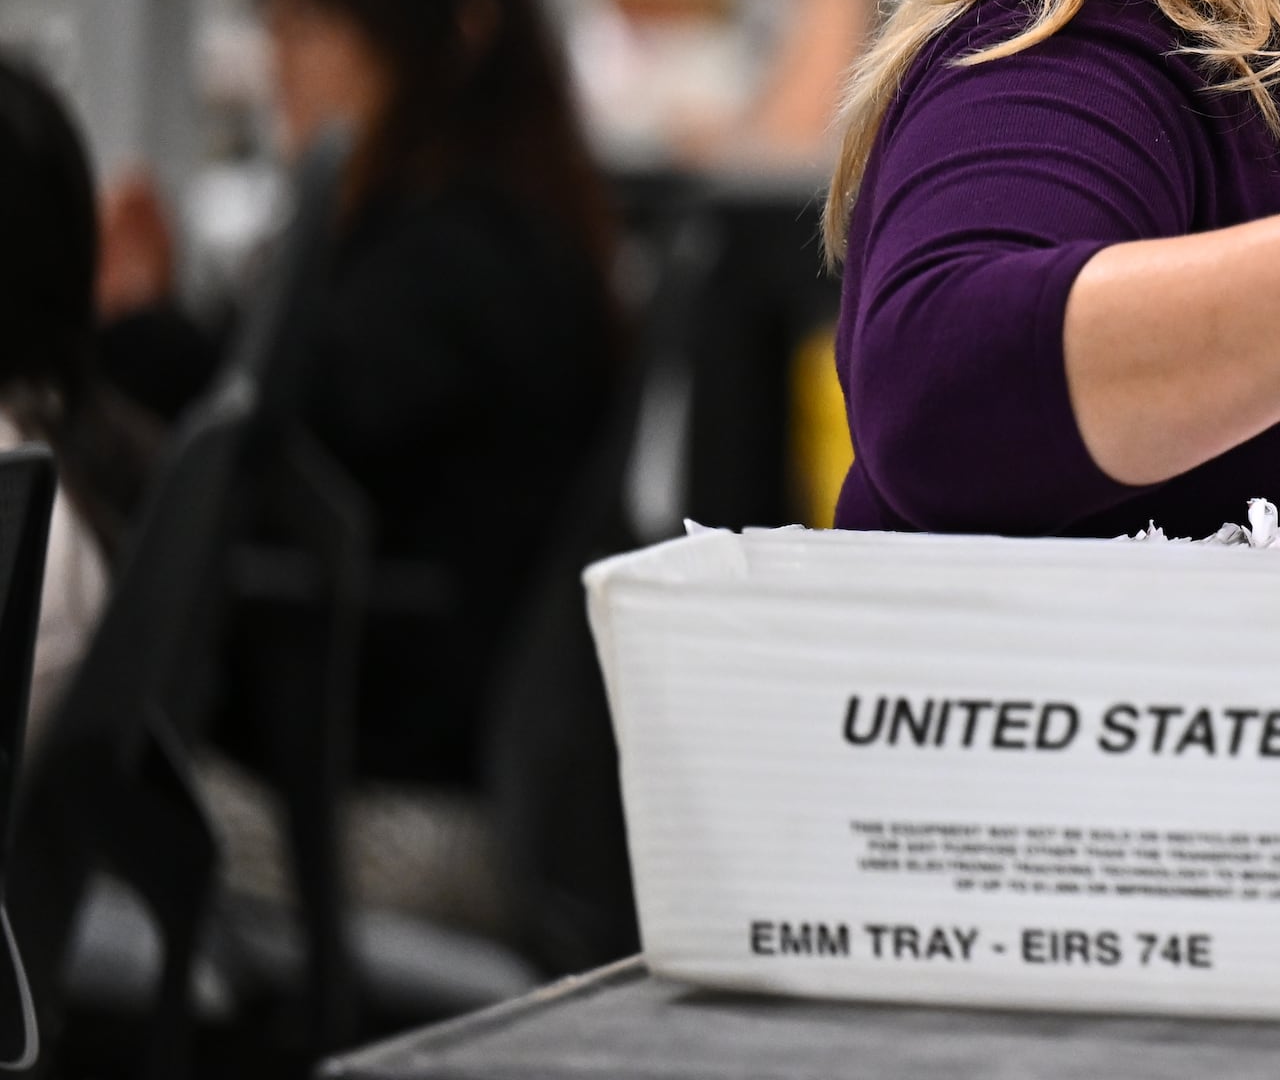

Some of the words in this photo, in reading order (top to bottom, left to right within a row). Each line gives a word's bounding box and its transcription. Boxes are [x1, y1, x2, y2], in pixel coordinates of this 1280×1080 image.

[842, 693, 1081, 752] UNITED
[750, 920, 850, 959] EMM
[863, 923, 979, 962] TRAY
[1021, 928, 1122, 966] EIRS
[1136, 931, 1214, 969] 74E
